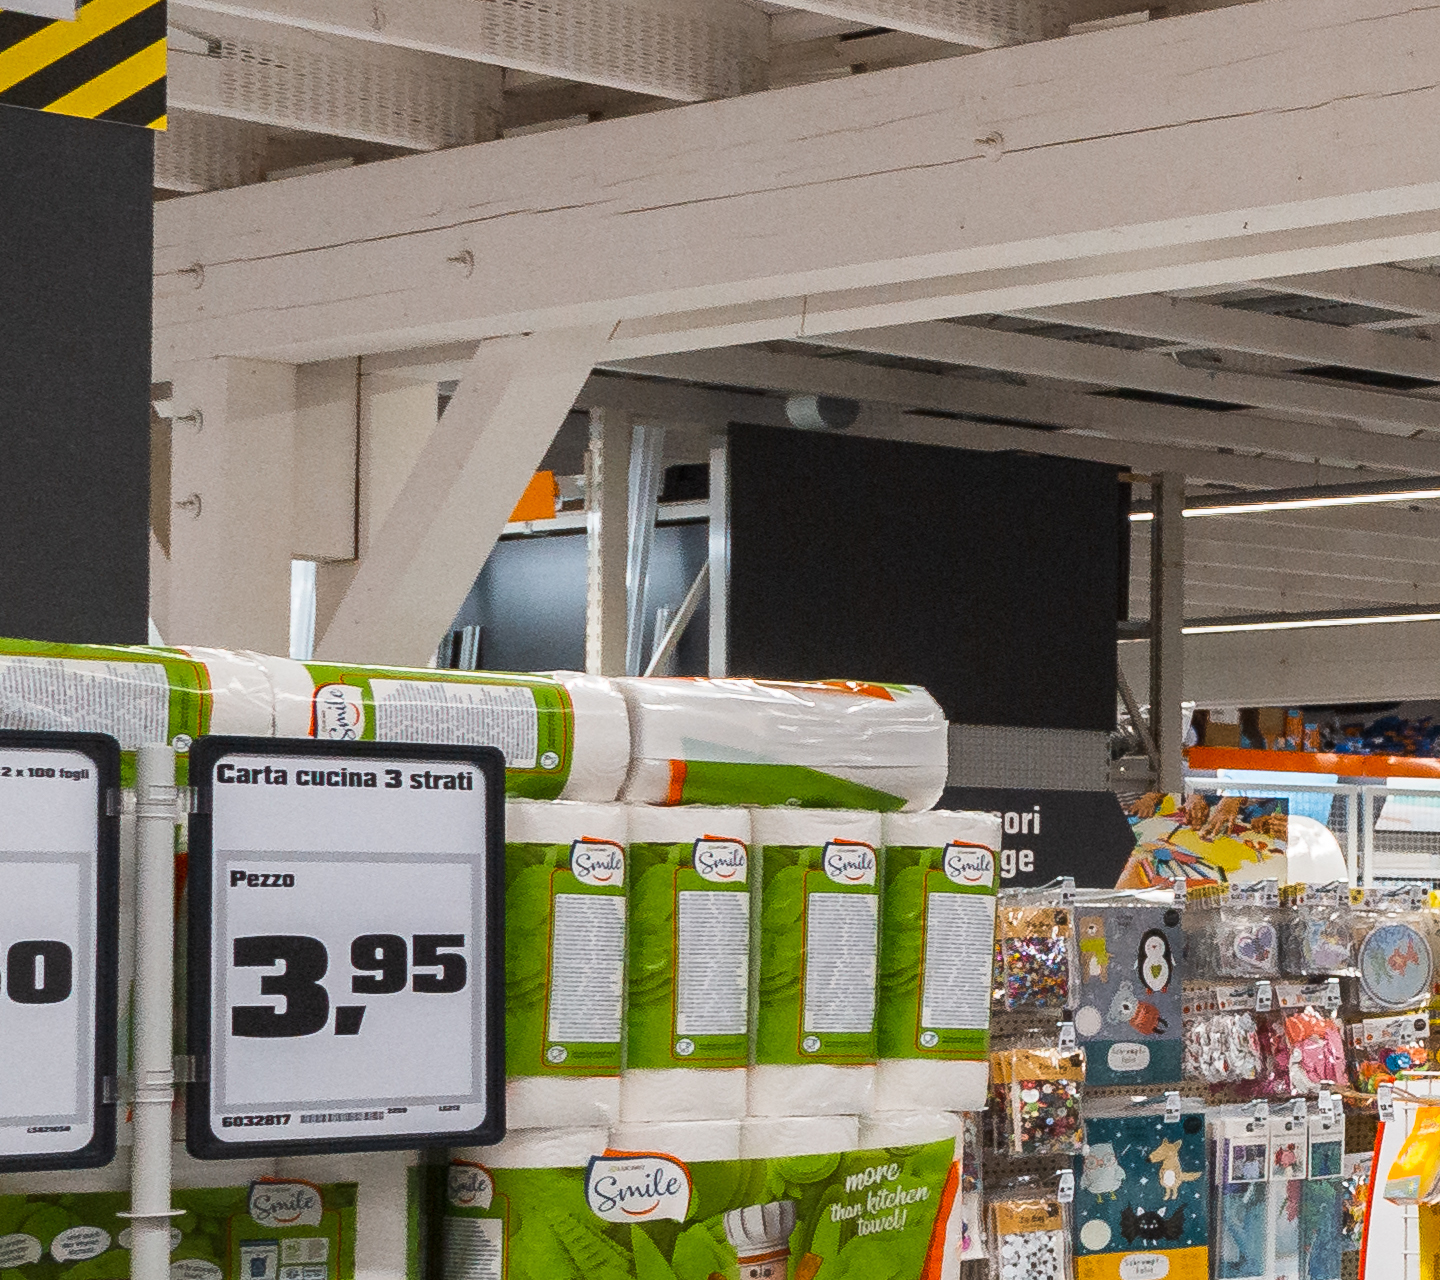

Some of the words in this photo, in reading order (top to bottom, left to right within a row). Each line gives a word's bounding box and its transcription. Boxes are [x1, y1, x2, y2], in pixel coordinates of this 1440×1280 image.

[27, 767, 56, 779] 100
[217, 764, 288, 786] Carta
[295, 769, 378, 788] cucina
[384, 769, 403, 789] 3
[409, 769, 475, 791] strati
[1000, 805, 1041, 835] ori
[229, 869, 295, 888] Pezzo
[221, 1113, 292, 1128] 6032817
[843, 1159, 900, 1194] more
[593, 1173, 682, 1213] Smile
[830, 1200, 863, 1223] than
[865, 1184, 930, 1215] kitchen
[856, 1207, 908, 1238] towel!
